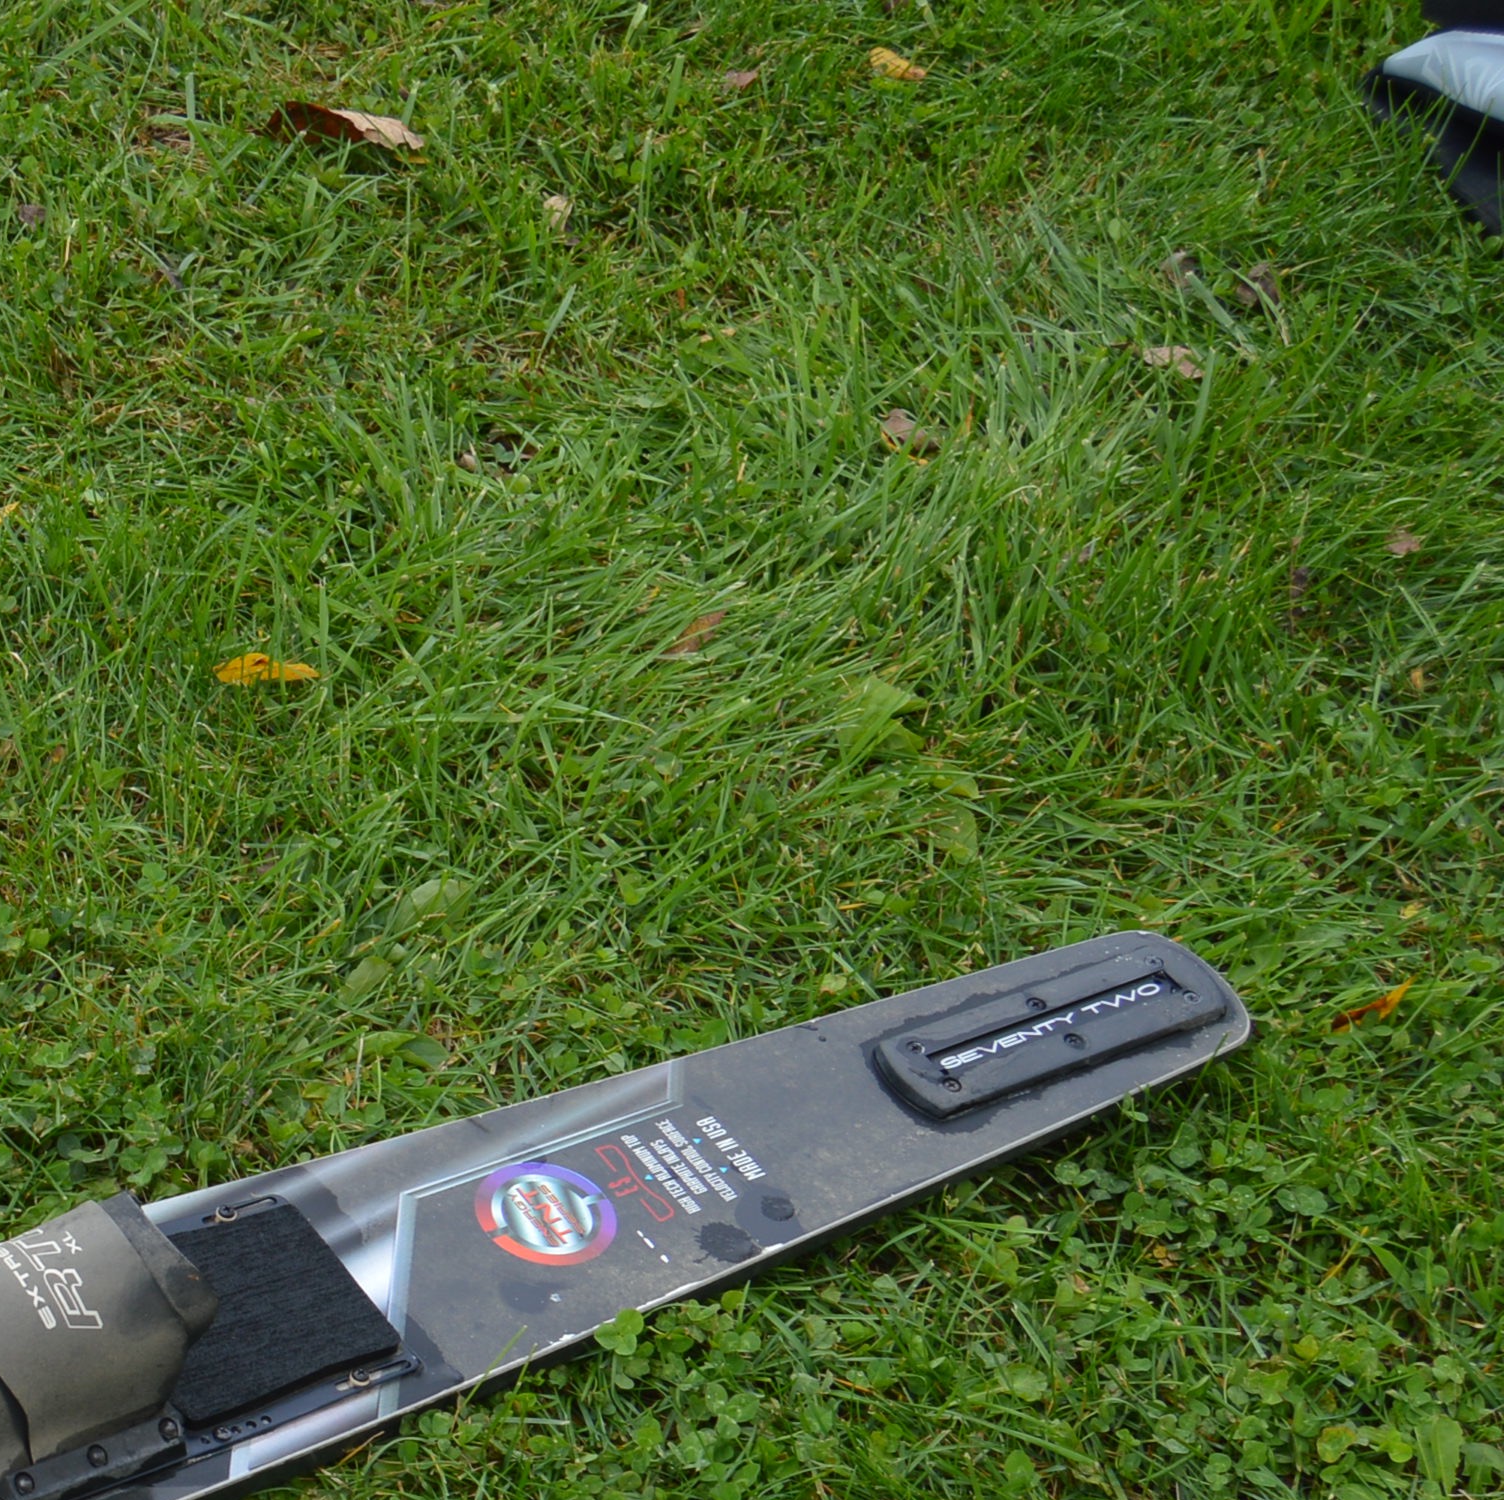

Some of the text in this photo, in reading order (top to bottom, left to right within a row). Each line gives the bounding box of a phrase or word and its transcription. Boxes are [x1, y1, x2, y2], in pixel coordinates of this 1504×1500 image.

[940, 983, 1161, 1070] SEVENTY TWO
[620, 1134, 641, 1149] TOP
[650, 1138, 708, 1195] GRAPHITE INLAYS
[654, 1118, 738, 1202] VELOCITY CONTROL SURFACE
[696, 1116, 767, 1181] MADE IN USA
[516, 1187, 573, 1244] TNT
[662, 1178, 686, 1199] TECH
[62, 1230, 83, 1255] XL
